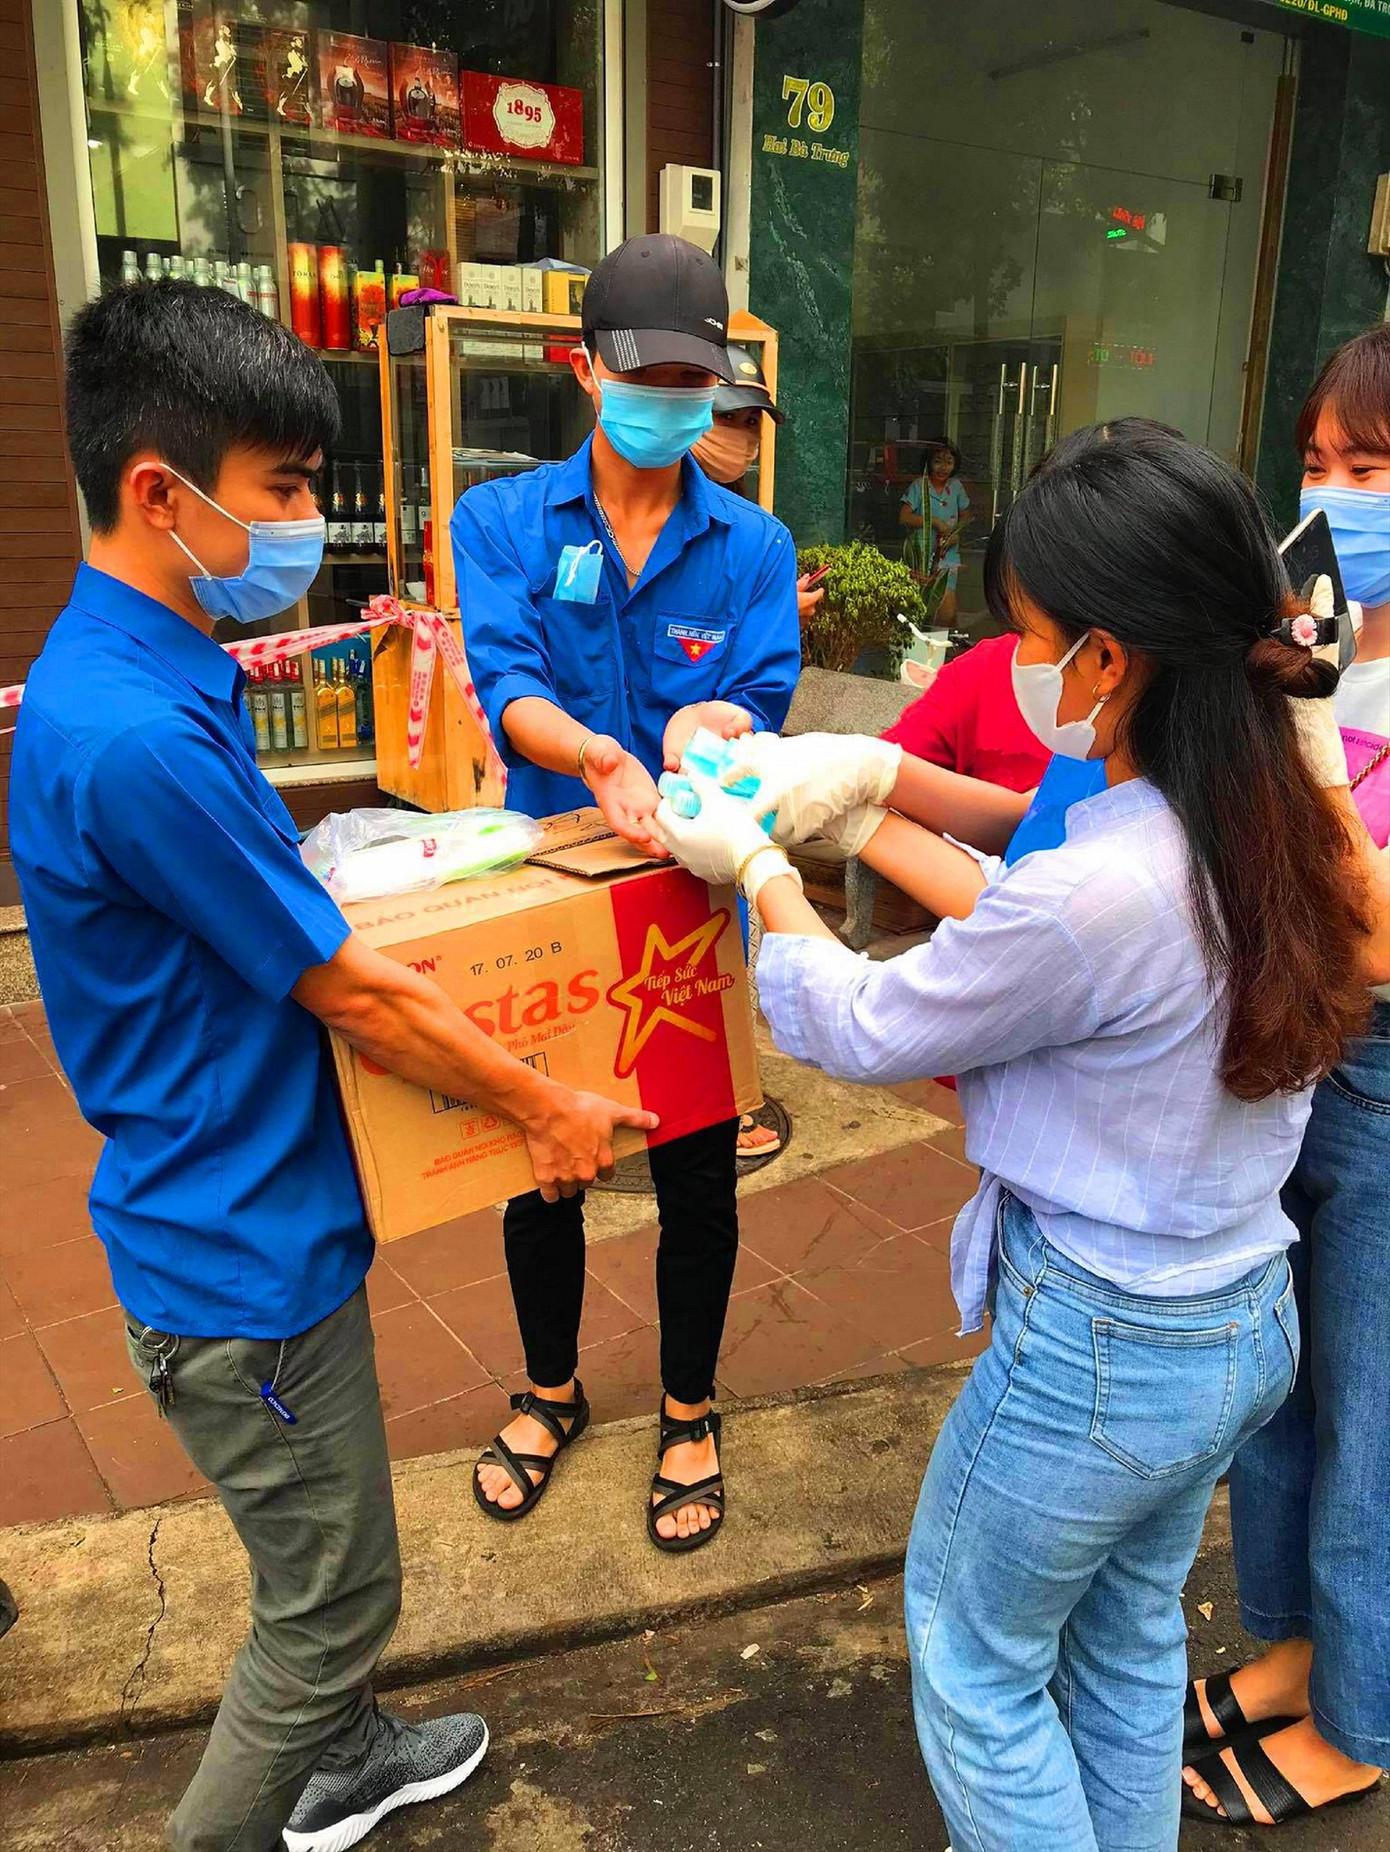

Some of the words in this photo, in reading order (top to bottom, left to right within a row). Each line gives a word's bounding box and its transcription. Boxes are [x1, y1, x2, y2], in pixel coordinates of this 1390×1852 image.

[507, 99, 542, 123] 1895
[782, 75, 835, 133] 79
[762, 134, 788, 155] Hai
[789, 139, 809, 158] Bà
[470, 962, 488, 976] 17.
[495, 954, 518, 970] 07.
[524, 947, 543, 962] 20
[551, 941, 562, 954] B
[644, 970, 671, 991] Tiếp
[674, 964, 698, 983] Sức
[661, 984, 693, 1007] Việt
[695, 974, 734, 997] Nam
